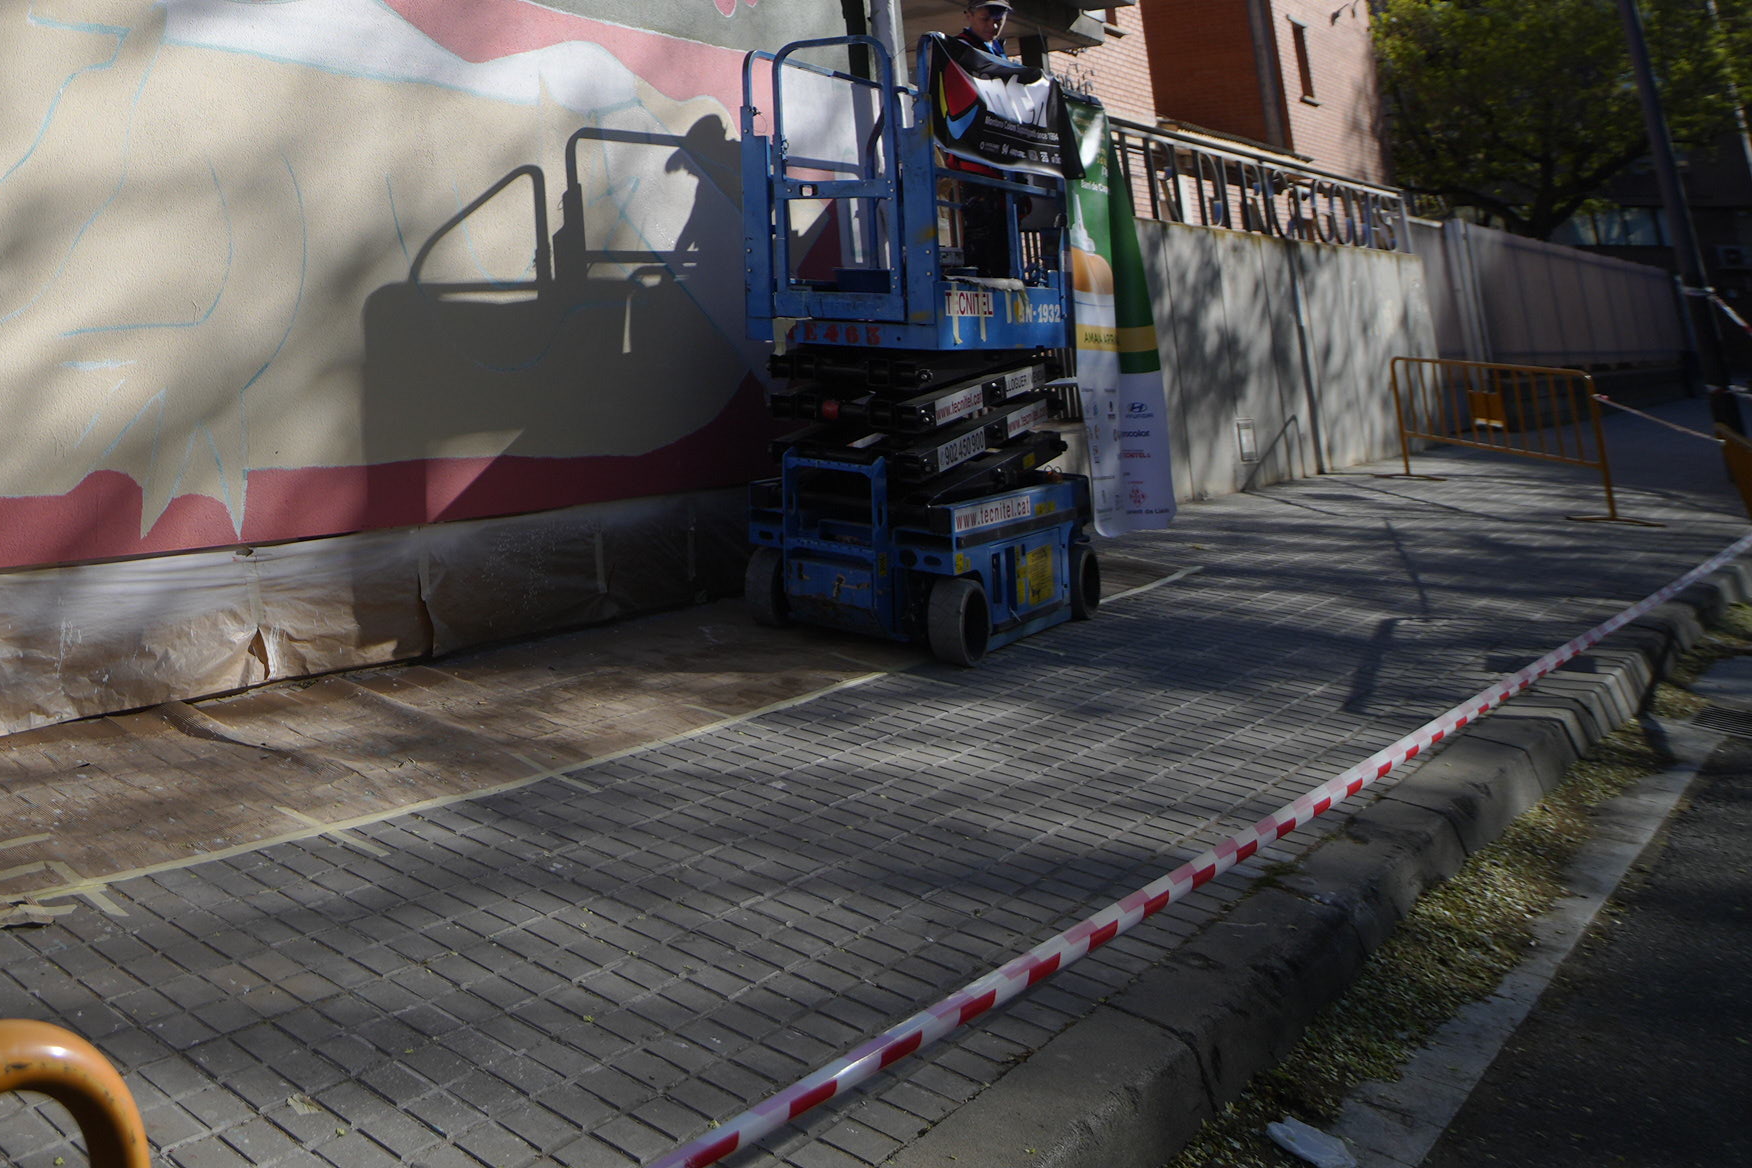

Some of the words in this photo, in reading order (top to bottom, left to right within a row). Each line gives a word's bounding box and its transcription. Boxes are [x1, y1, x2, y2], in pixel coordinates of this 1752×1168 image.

[945, 292, 993, 316] TCNITL
[1020, 303, 1061, 323] N-1932
[955, 499, 1030, 530] www.tecnitel.cat
